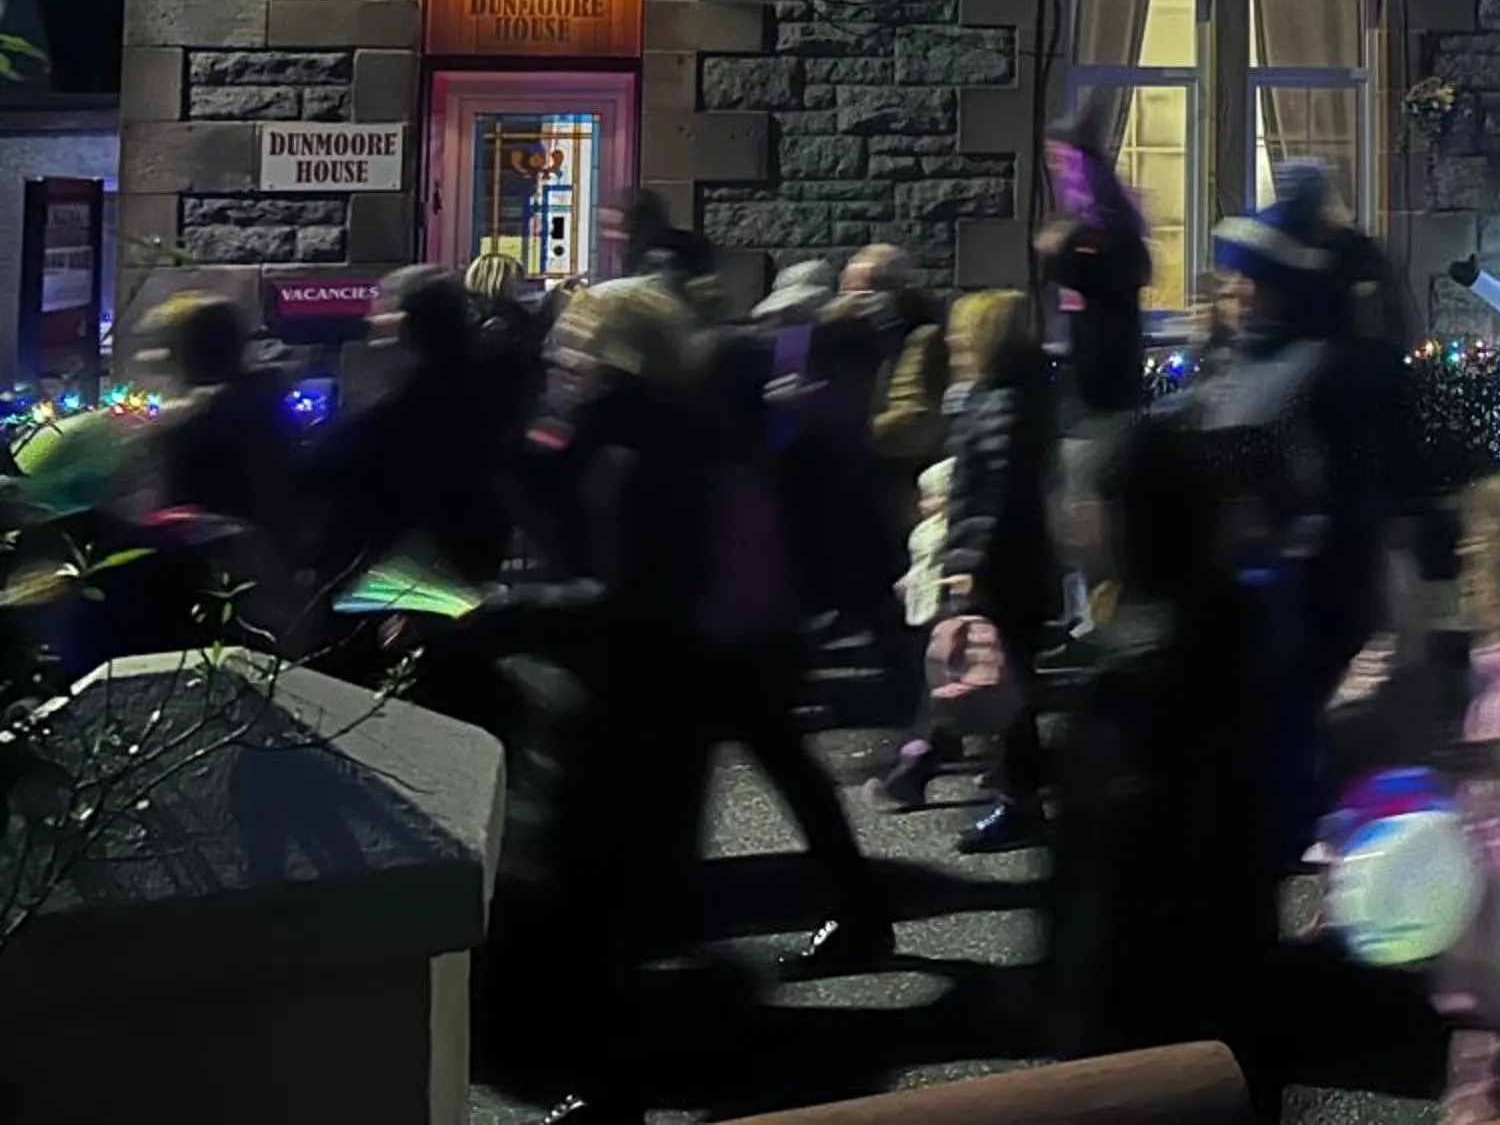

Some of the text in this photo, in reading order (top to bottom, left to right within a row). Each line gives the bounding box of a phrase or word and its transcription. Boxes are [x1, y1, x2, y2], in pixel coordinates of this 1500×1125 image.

[496, 18, 571, 43] HOUSE
[269, 132, 398, 158] DUNMOORE
[298, 161, 370, 186] HOUSE
[280, 285, 380, 301] VACANCIES
